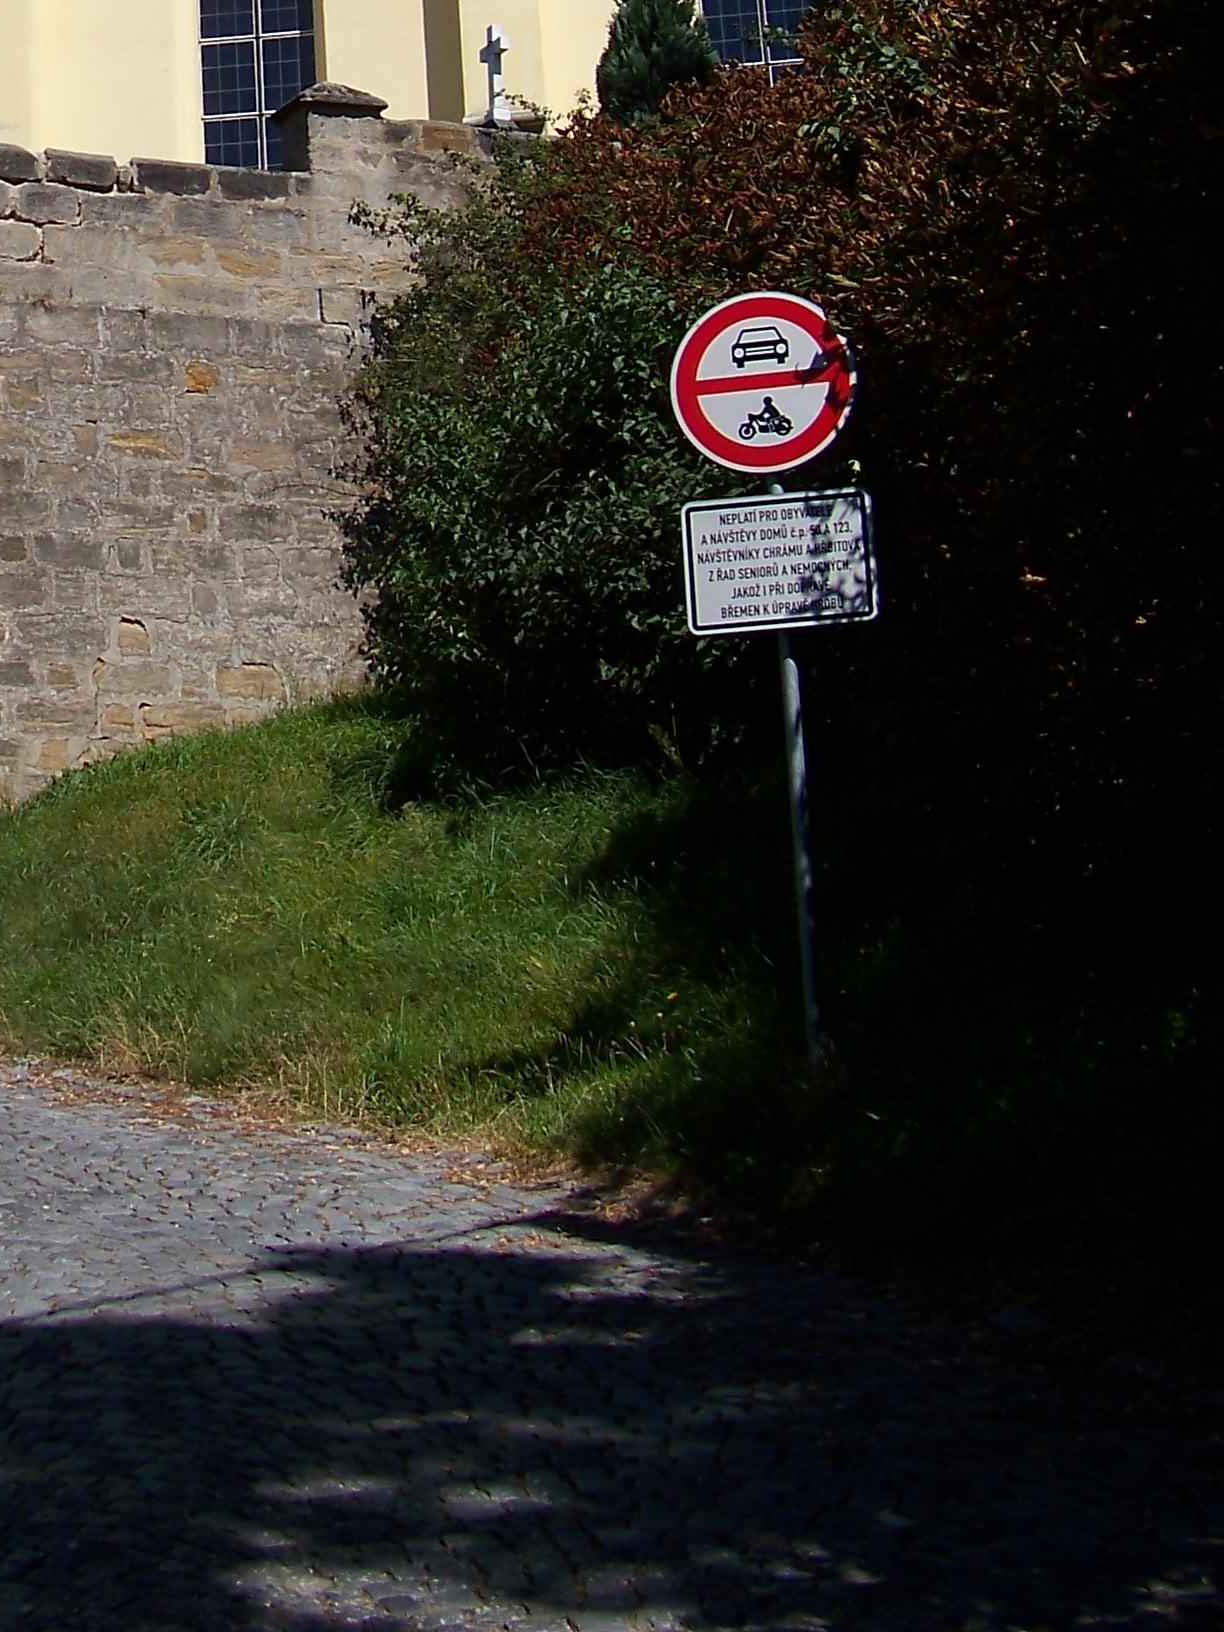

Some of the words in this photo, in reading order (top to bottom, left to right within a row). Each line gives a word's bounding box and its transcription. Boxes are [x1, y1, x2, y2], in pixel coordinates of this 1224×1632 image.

[720, 511, 757, 525] NEPLATÍ
[760, 510, 778, 521] PRO
[702, 535, 707, 545] A
[710, 529, 757, 544] NÁVŠTĚVY
[760, 524, 787, 540] DOMŮ
[823, 524, 830, 535] A
[763, 542, 802, 558] CHRÁMU
[709, 571, 714, 582] Z
[717, 567, 735, 581] ŘAD
[738, 562, 778, 579] SENIORŮ
[782, 565, 788, 576] A
[731, 584, 760, 599] JAKOŽ
[763, 585, 766, 596] I
[769, 581, 784, 595] PŘI
[721, 603, 760, 619] BŘEMEN
[763, 602, 770, 613] K
